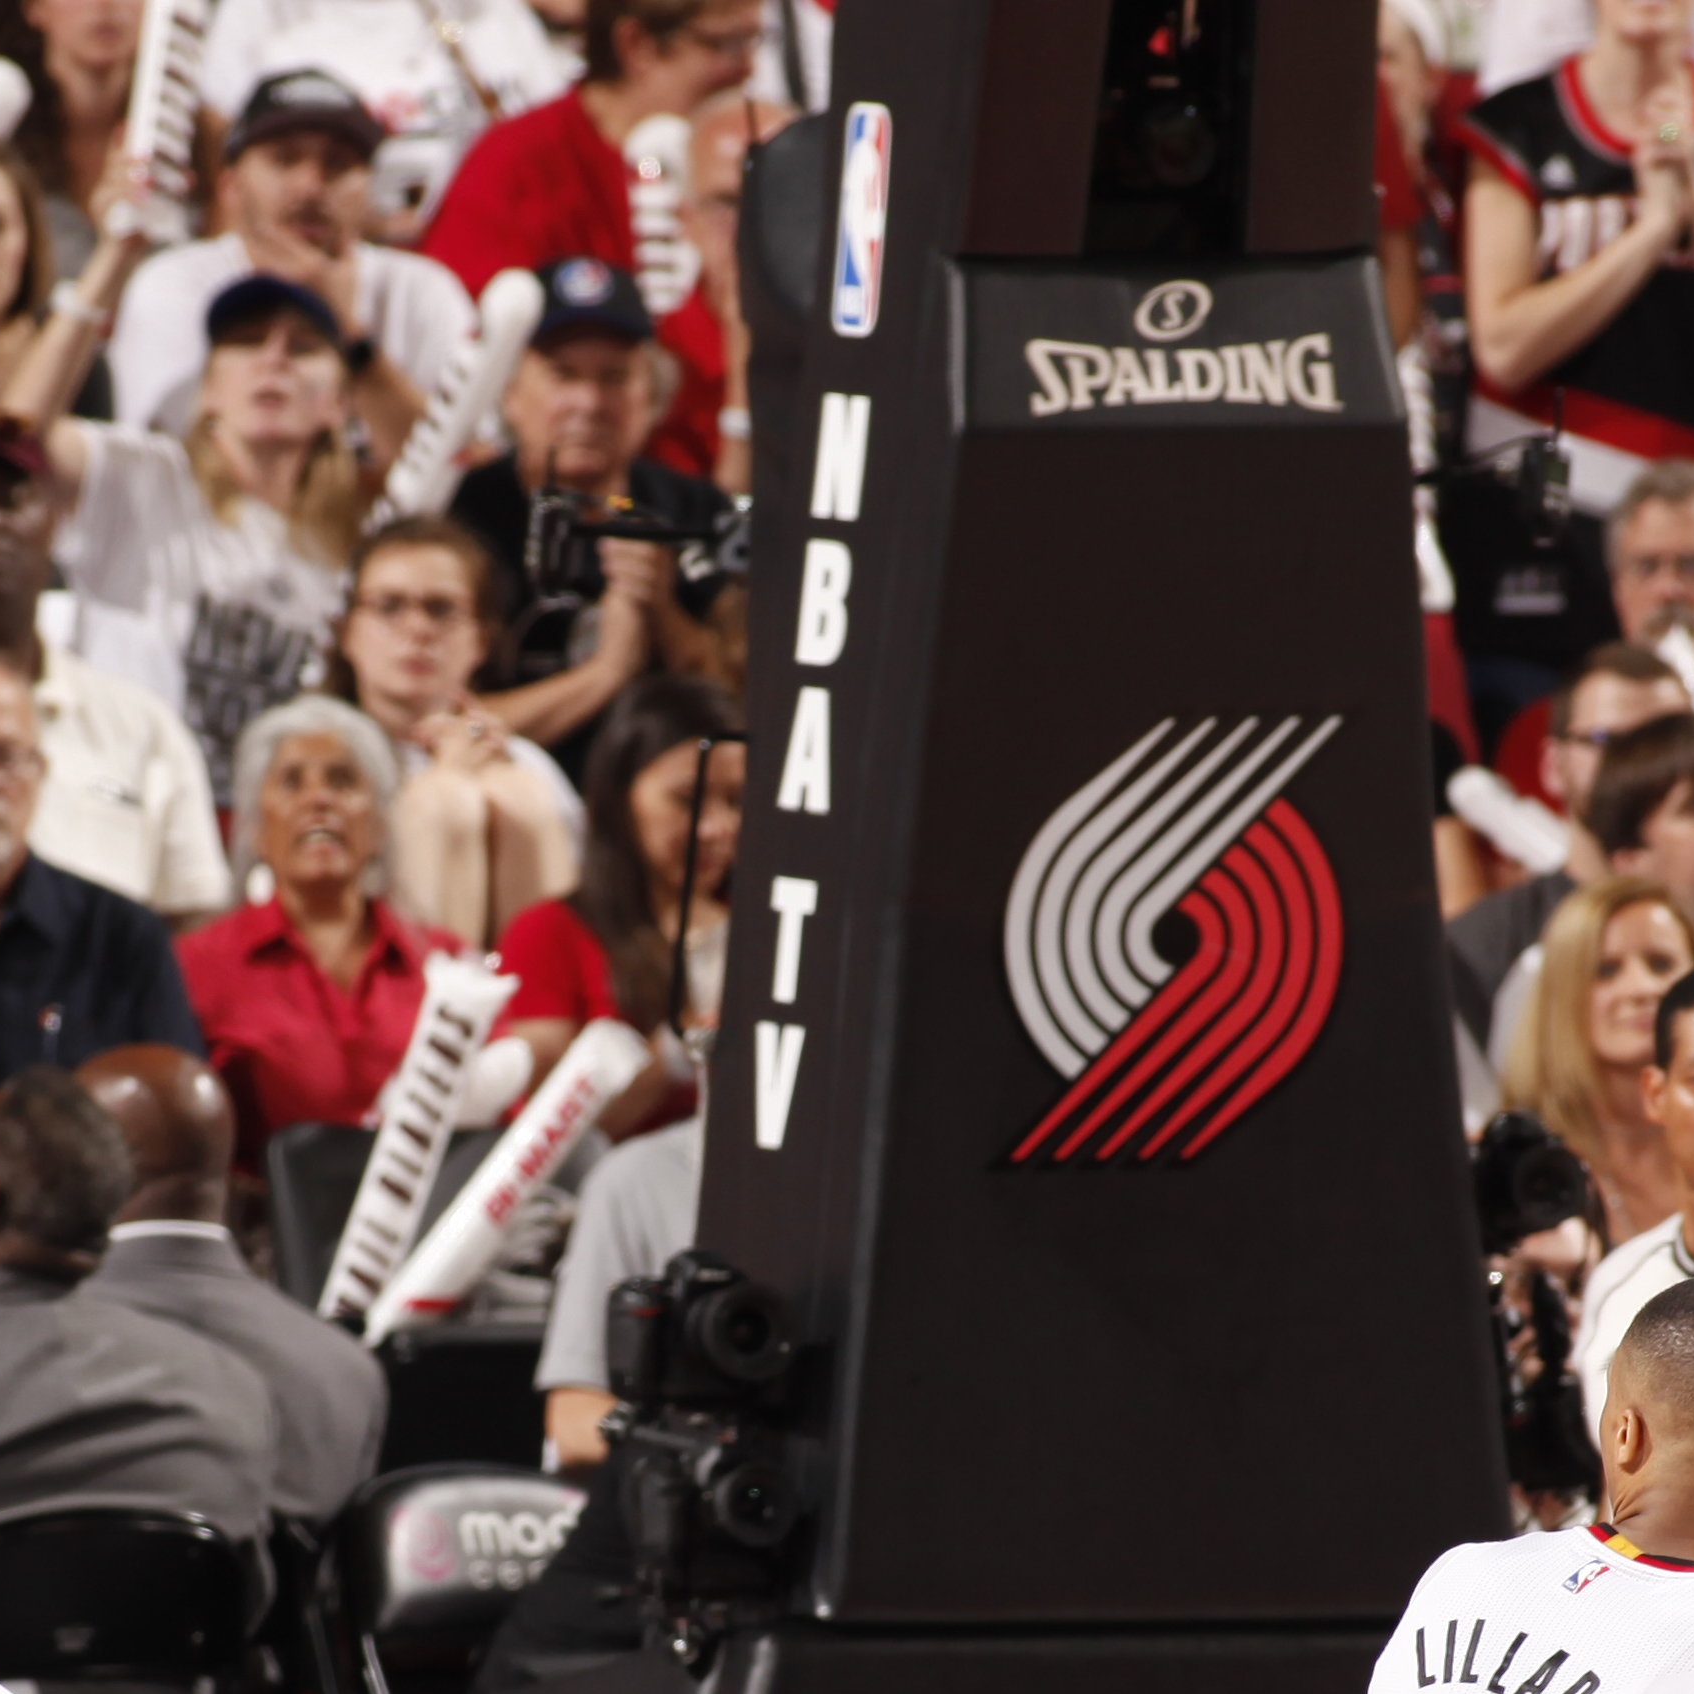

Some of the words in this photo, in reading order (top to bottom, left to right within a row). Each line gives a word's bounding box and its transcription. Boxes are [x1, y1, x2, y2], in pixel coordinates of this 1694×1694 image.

[1024, 333, 1346, 416] SPALDING
[777, 391, 872, 816] NBA
[754, 876, 818, 1151] TV
